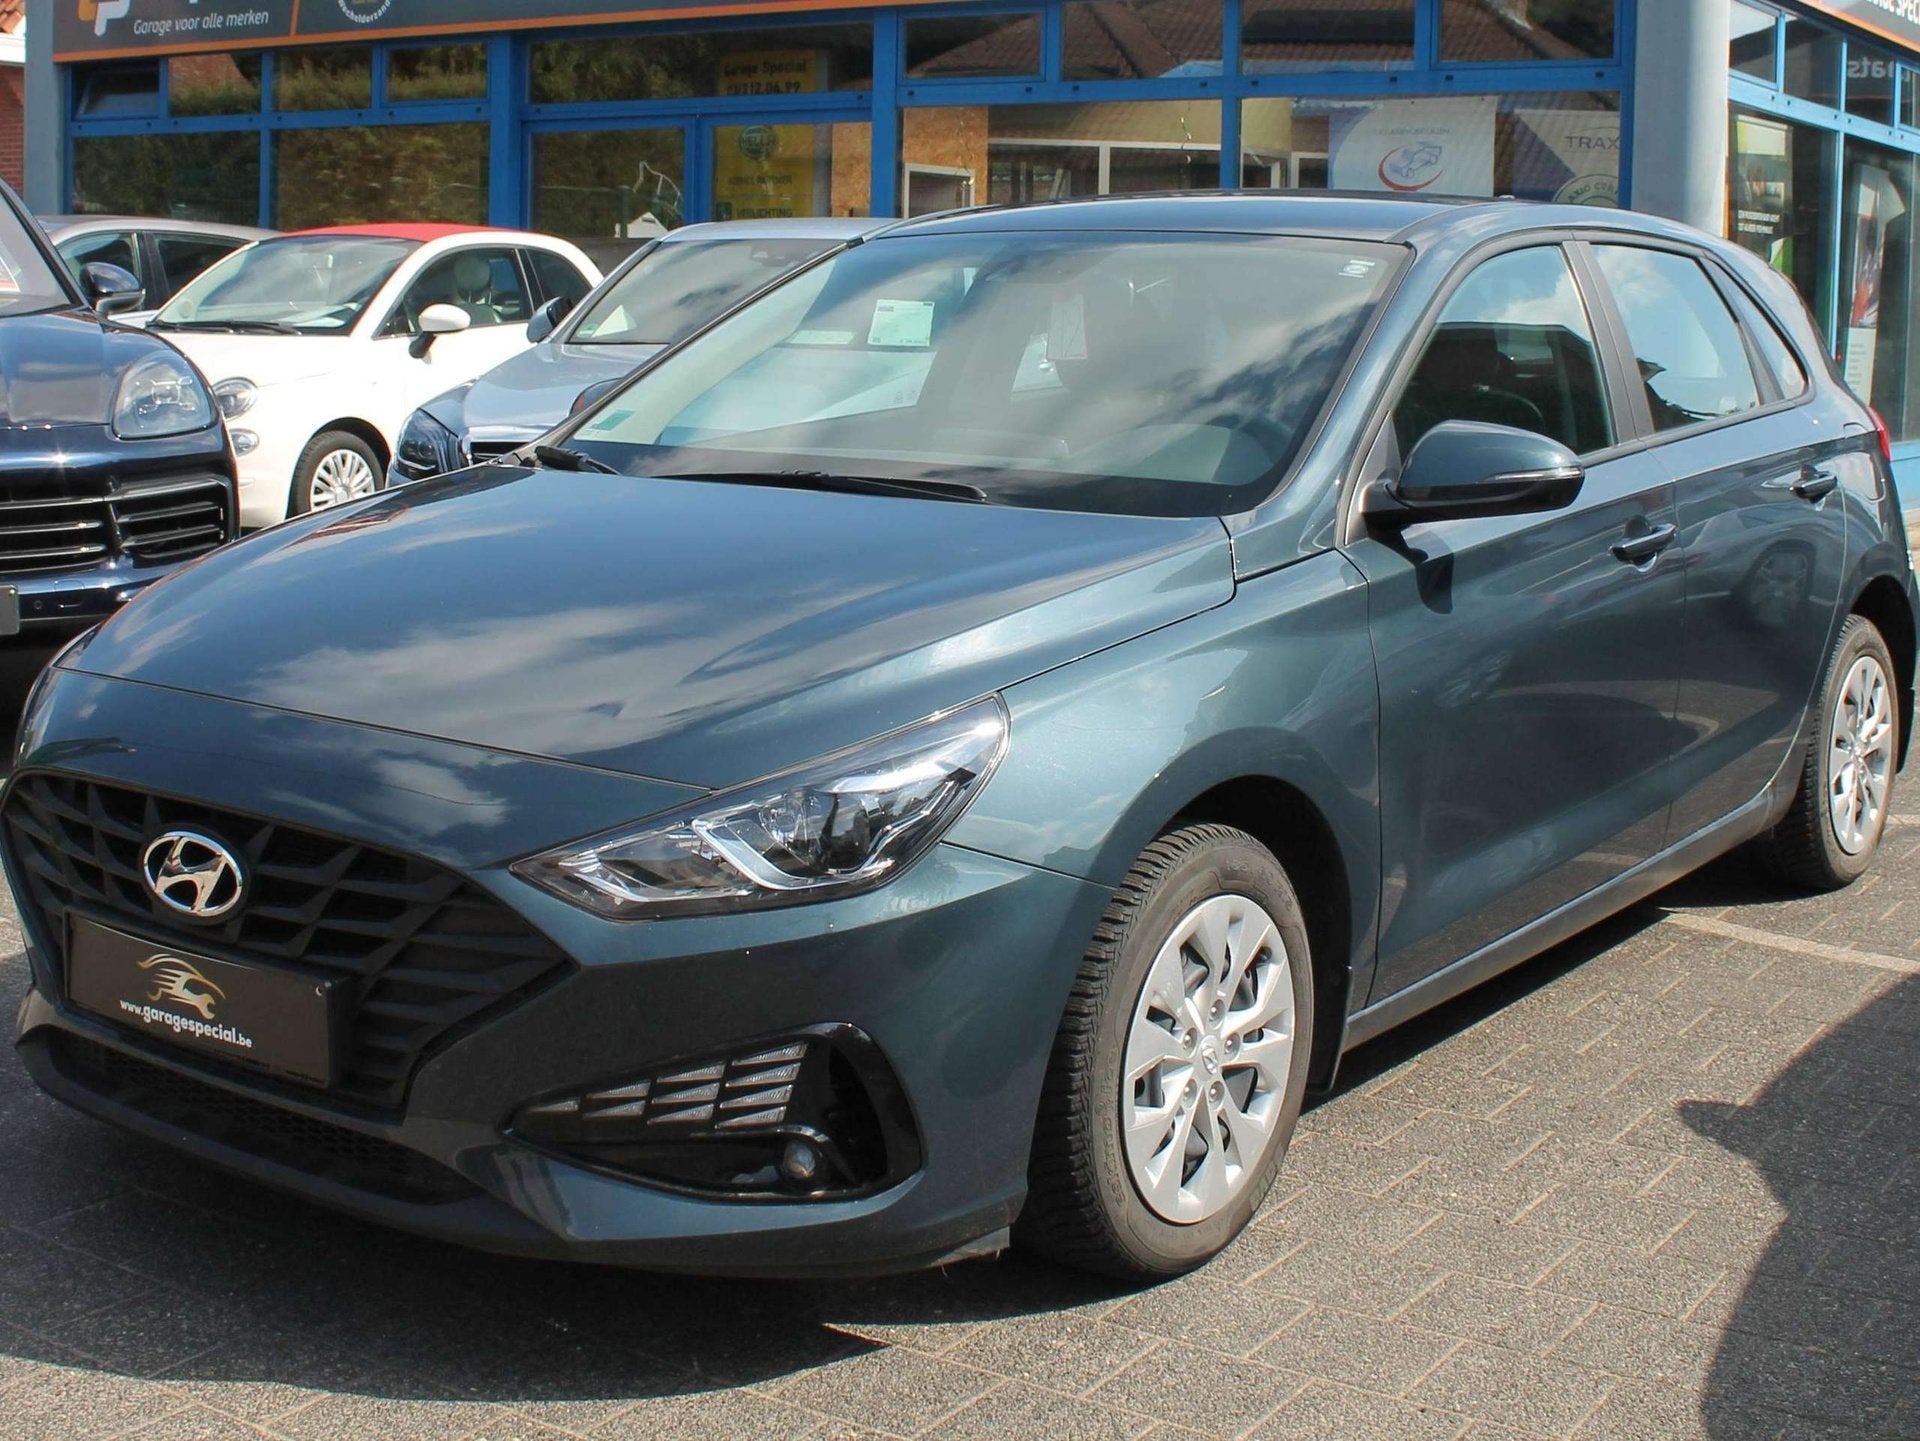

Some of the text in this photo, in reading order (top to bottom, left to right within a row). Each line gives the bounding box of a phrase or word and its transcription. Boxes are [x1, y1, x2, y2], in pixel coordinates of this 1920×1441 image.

[133, 9, 269, 36] Garage voor alle merken
[762, 59, 806, 76] Special
[1564, 135, 1620, 150] TRAX
[120, 999, 253, 1048] www.garagespecial.be
